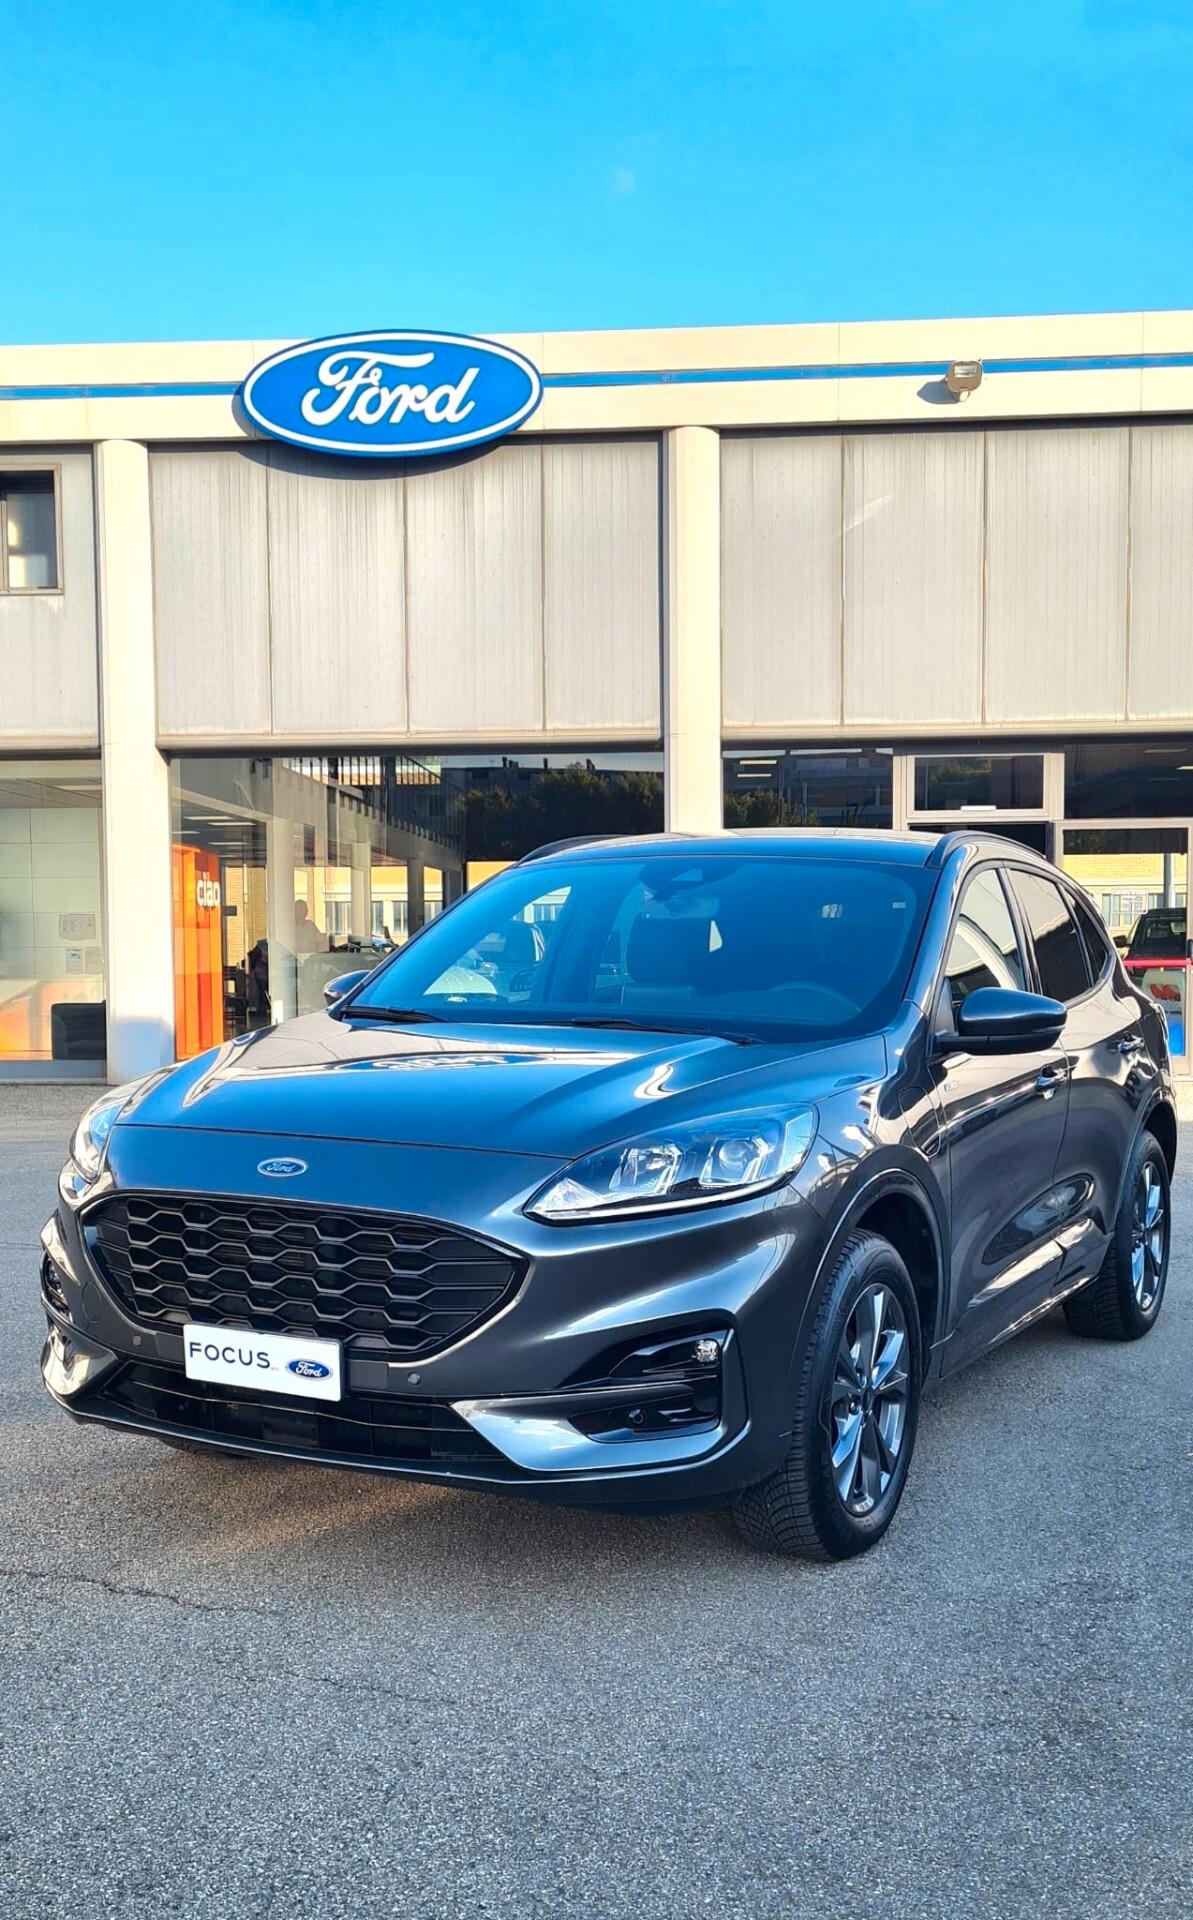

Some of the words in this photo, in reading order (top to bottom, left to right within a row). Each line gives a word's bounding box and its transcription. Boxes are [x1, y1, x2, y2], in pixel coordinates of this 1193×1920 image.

[301, 351, 480, 426] Ford
[197, 871, 221, 907] ciao
[266, 1161, 298, 1172] Ford
[189, 1341, 271, 1369] FOCUS
[295, 1361, 323, 1378] Ford
